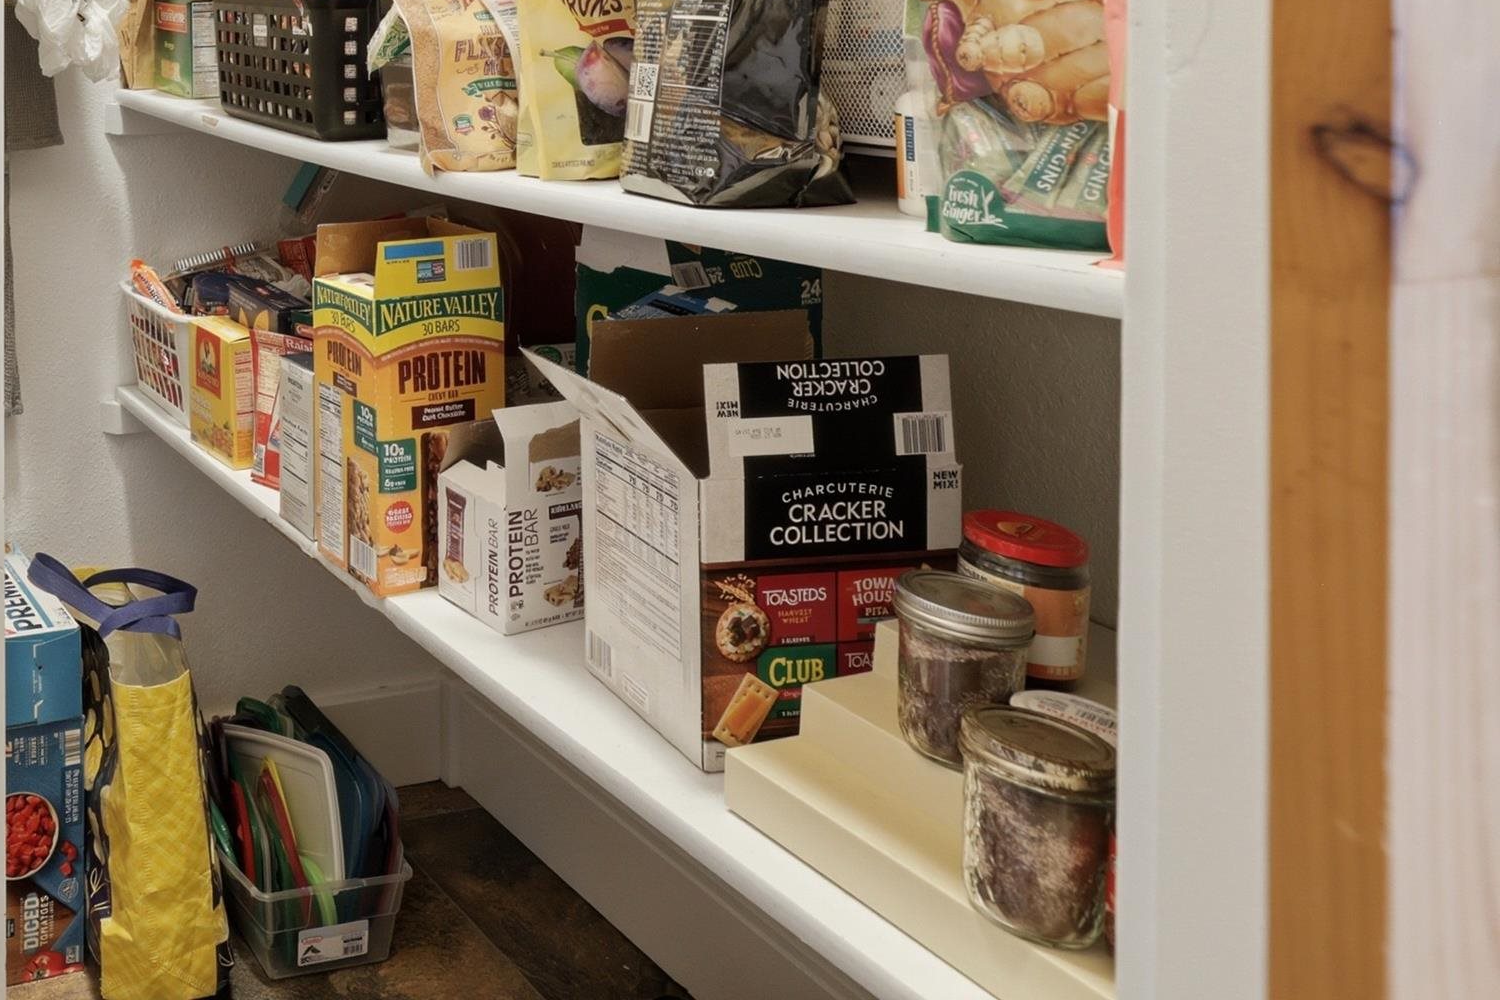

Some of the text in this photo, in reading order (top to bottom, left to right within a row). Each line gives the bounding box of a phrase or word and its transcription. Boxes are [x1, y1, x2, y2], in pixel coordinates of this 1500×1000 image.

[948, 185, 979, 208] Fresh
[943, 201, 984, 224] Ginger
[730, 258, 763, 279] CLUB
[801, 279, 822, 299] 24
[380, 292, 498, 332] NATURE VALLEY
[422, 320, 460, 336] 30 BARS
[286, 338, 314, 352] Raisi
[399, 350, 486, 395] PROTEIN
[777, 360, 885, 380] COLLECTION
[792, 379, 872, 397] CRACKER
[424, 404, 465, 415] Peanut Butter
[787, 395, 878, 412] CHARCUTERIE
[422, 410, 467, 423] Dark Chocolate
[717, 410, 739, 418] NEW
[383, 443, 405, 457] 10g
[933, 471, 958, 481] NEW
[933, 480, 959, 490] MIX!
[782, 482, 895, 504] CHARCUTERIE
[788, 500, 887, 523] CRACKER
[524, 508, 539, 547] BAR
[769, 520, 905, 546] COLLECTION
[508, 510, 524, 599] PROTEIN
[487, 553, 499, 617] PROTEIN
[762, 587, 827, 607] TOASTEDS
[852, 590, 893, 607] HOUS
[778, 609, 813, 618] HARVEST
[782, 617, 809, 625] WHEAT
[865, 607, 889, 617] PITA
[769, 656, 825, 688] CLUB
[24, 895, 40, 952] DICED
[40, 894, 49, 947] TOMATOES
